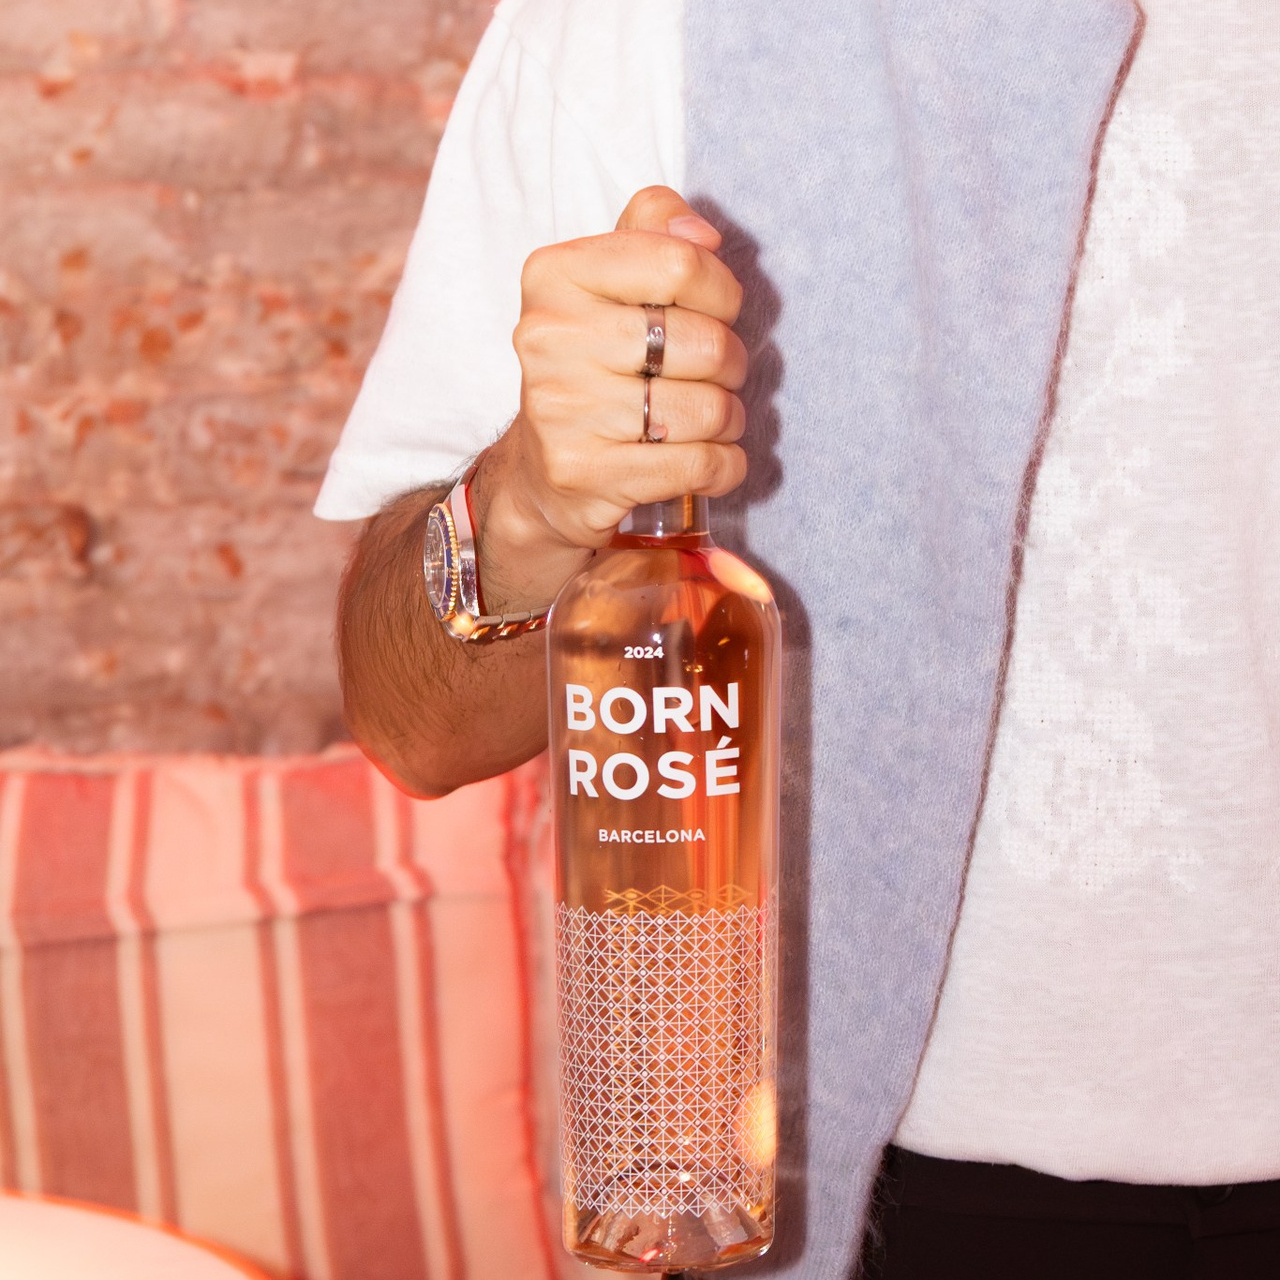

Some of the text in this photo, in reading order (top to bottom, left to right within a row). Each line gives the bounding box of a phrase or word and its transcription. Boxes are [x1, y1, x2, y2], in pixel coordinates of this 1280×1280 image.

[623, 646, 665, 659] 2024
[565, 682, 740, 735] BORN
[568, 735, 740, 801] ROSÉ
[598, 828, 706, 844] BARCELONA
